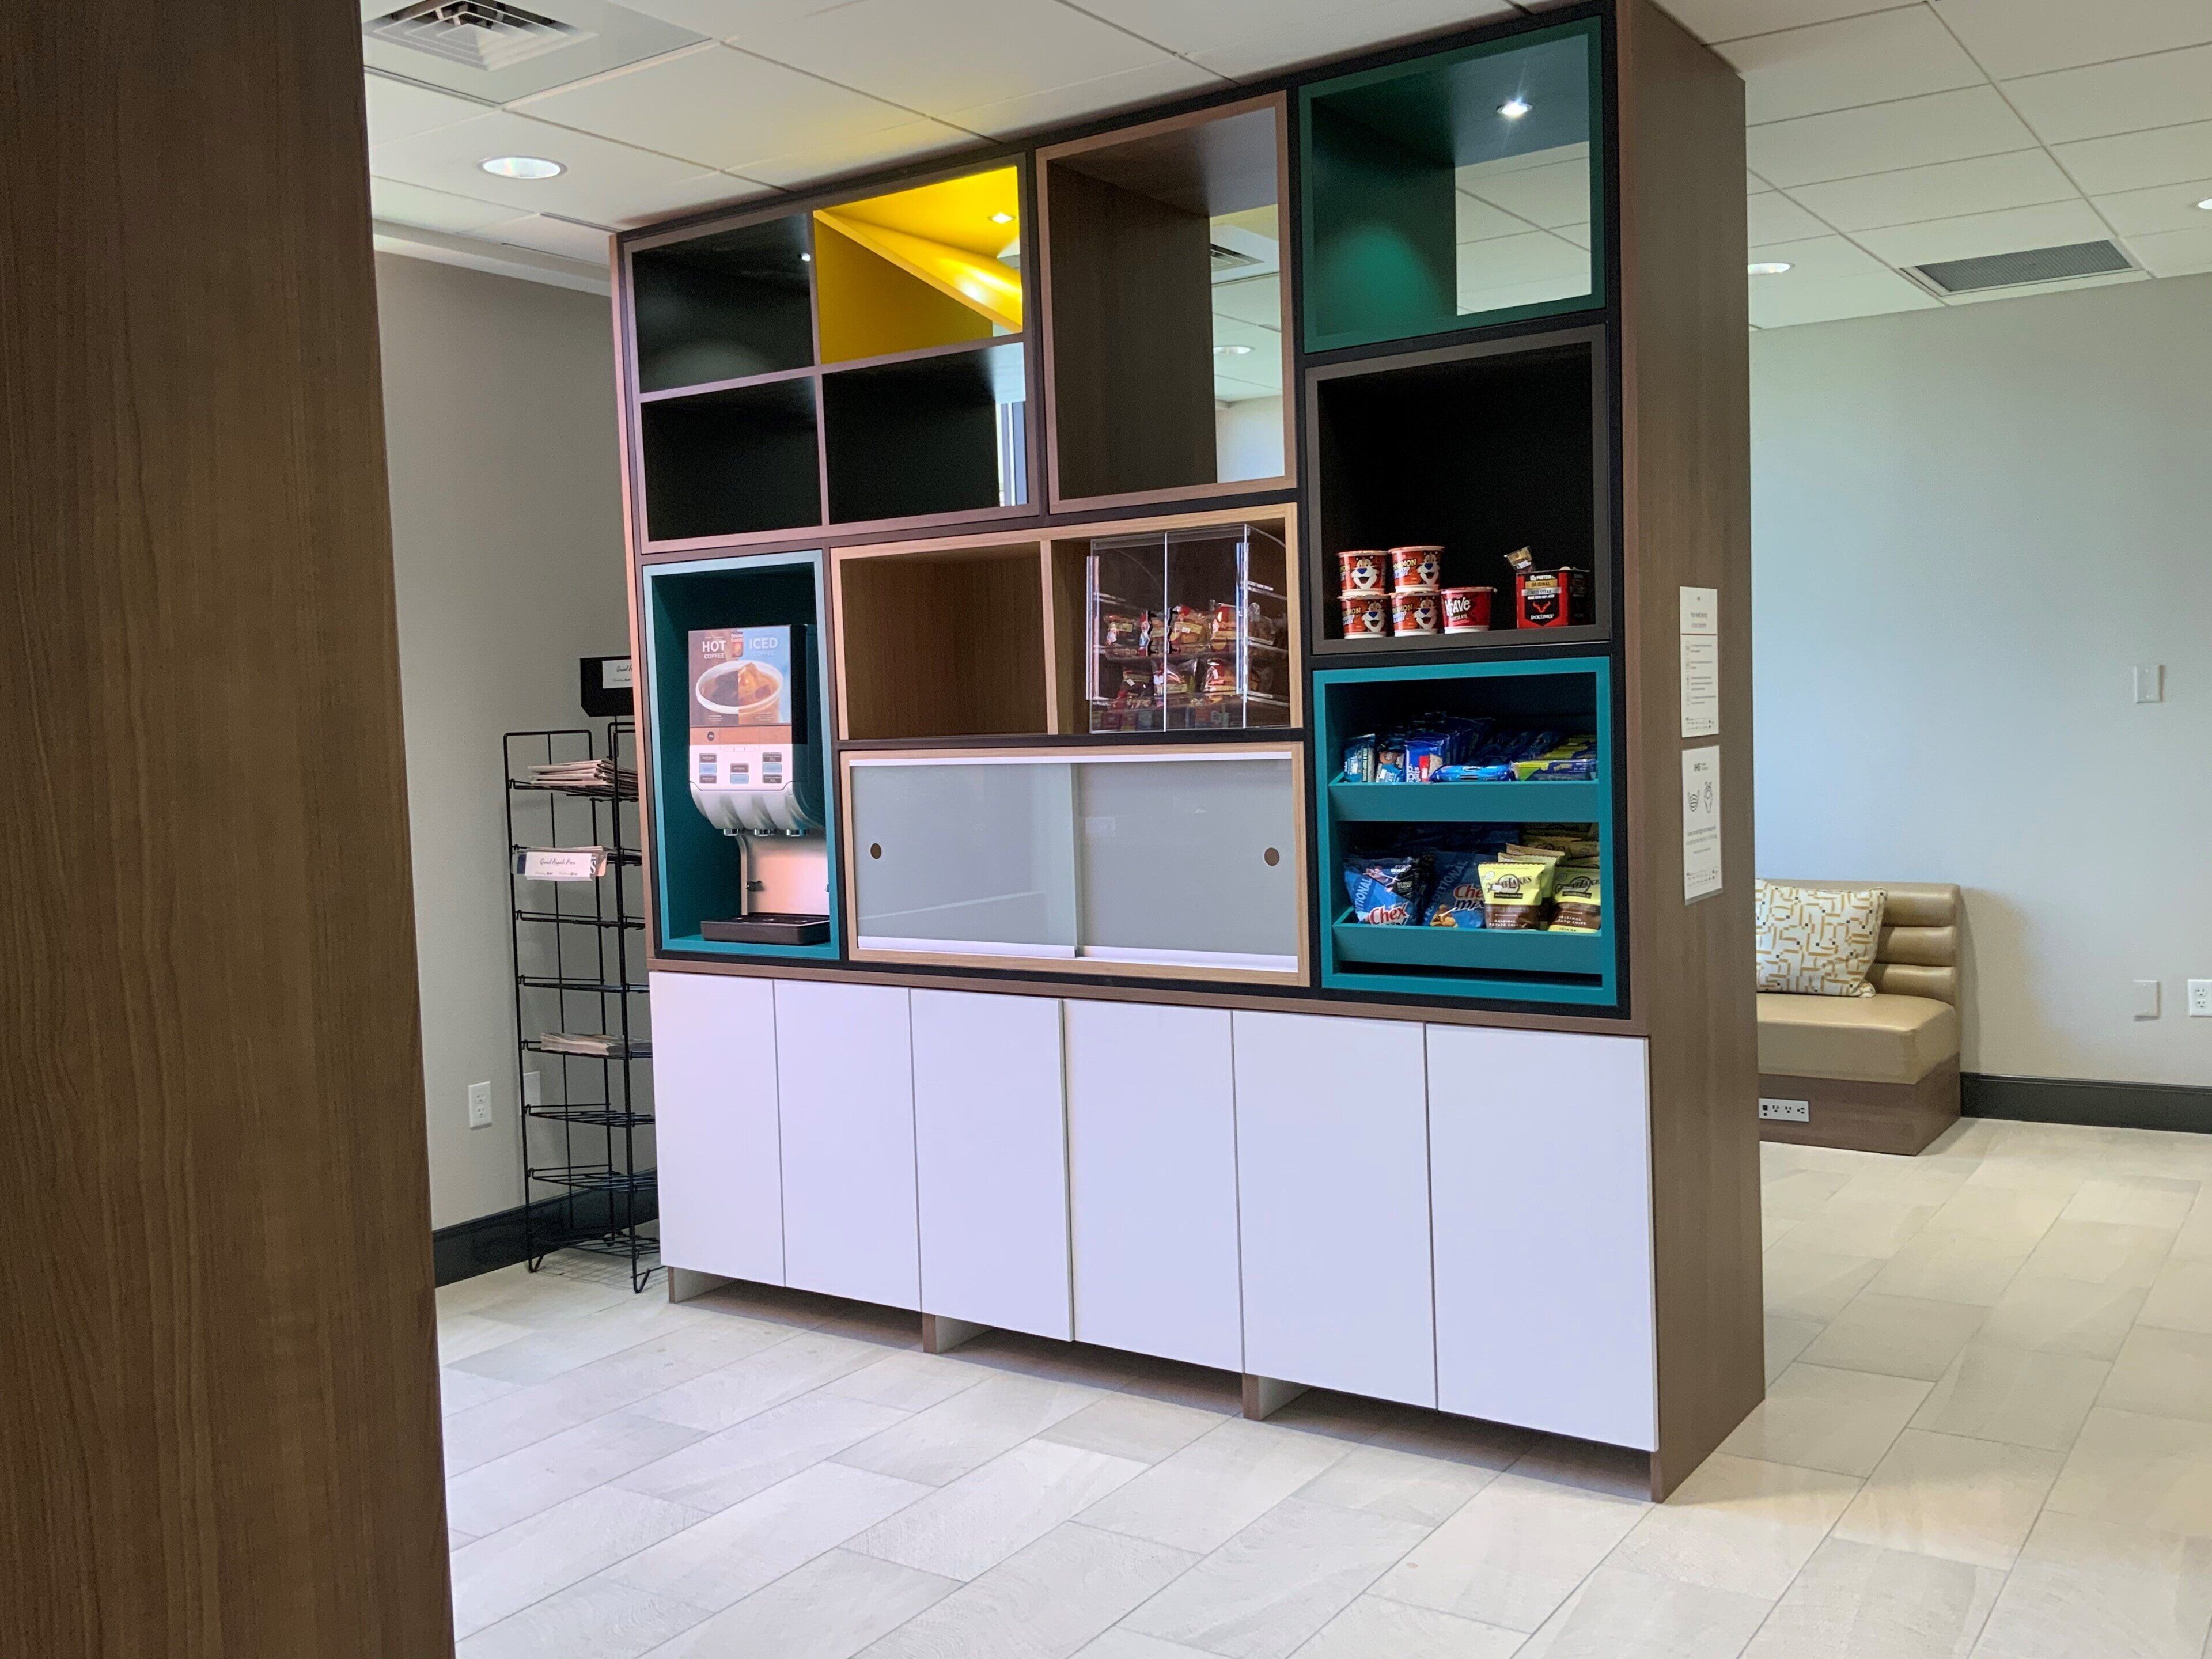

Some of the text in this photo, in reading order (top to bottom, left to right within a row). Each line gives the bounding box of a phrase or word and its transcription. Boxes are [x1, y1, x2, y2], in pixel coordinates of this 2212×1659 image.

[702, 640, 726, 652] HOT
[749, 637, 778, 650] ICED
[1454, 885, 1484, 898] Che
[1370, 907, 1407, 925] Chex
